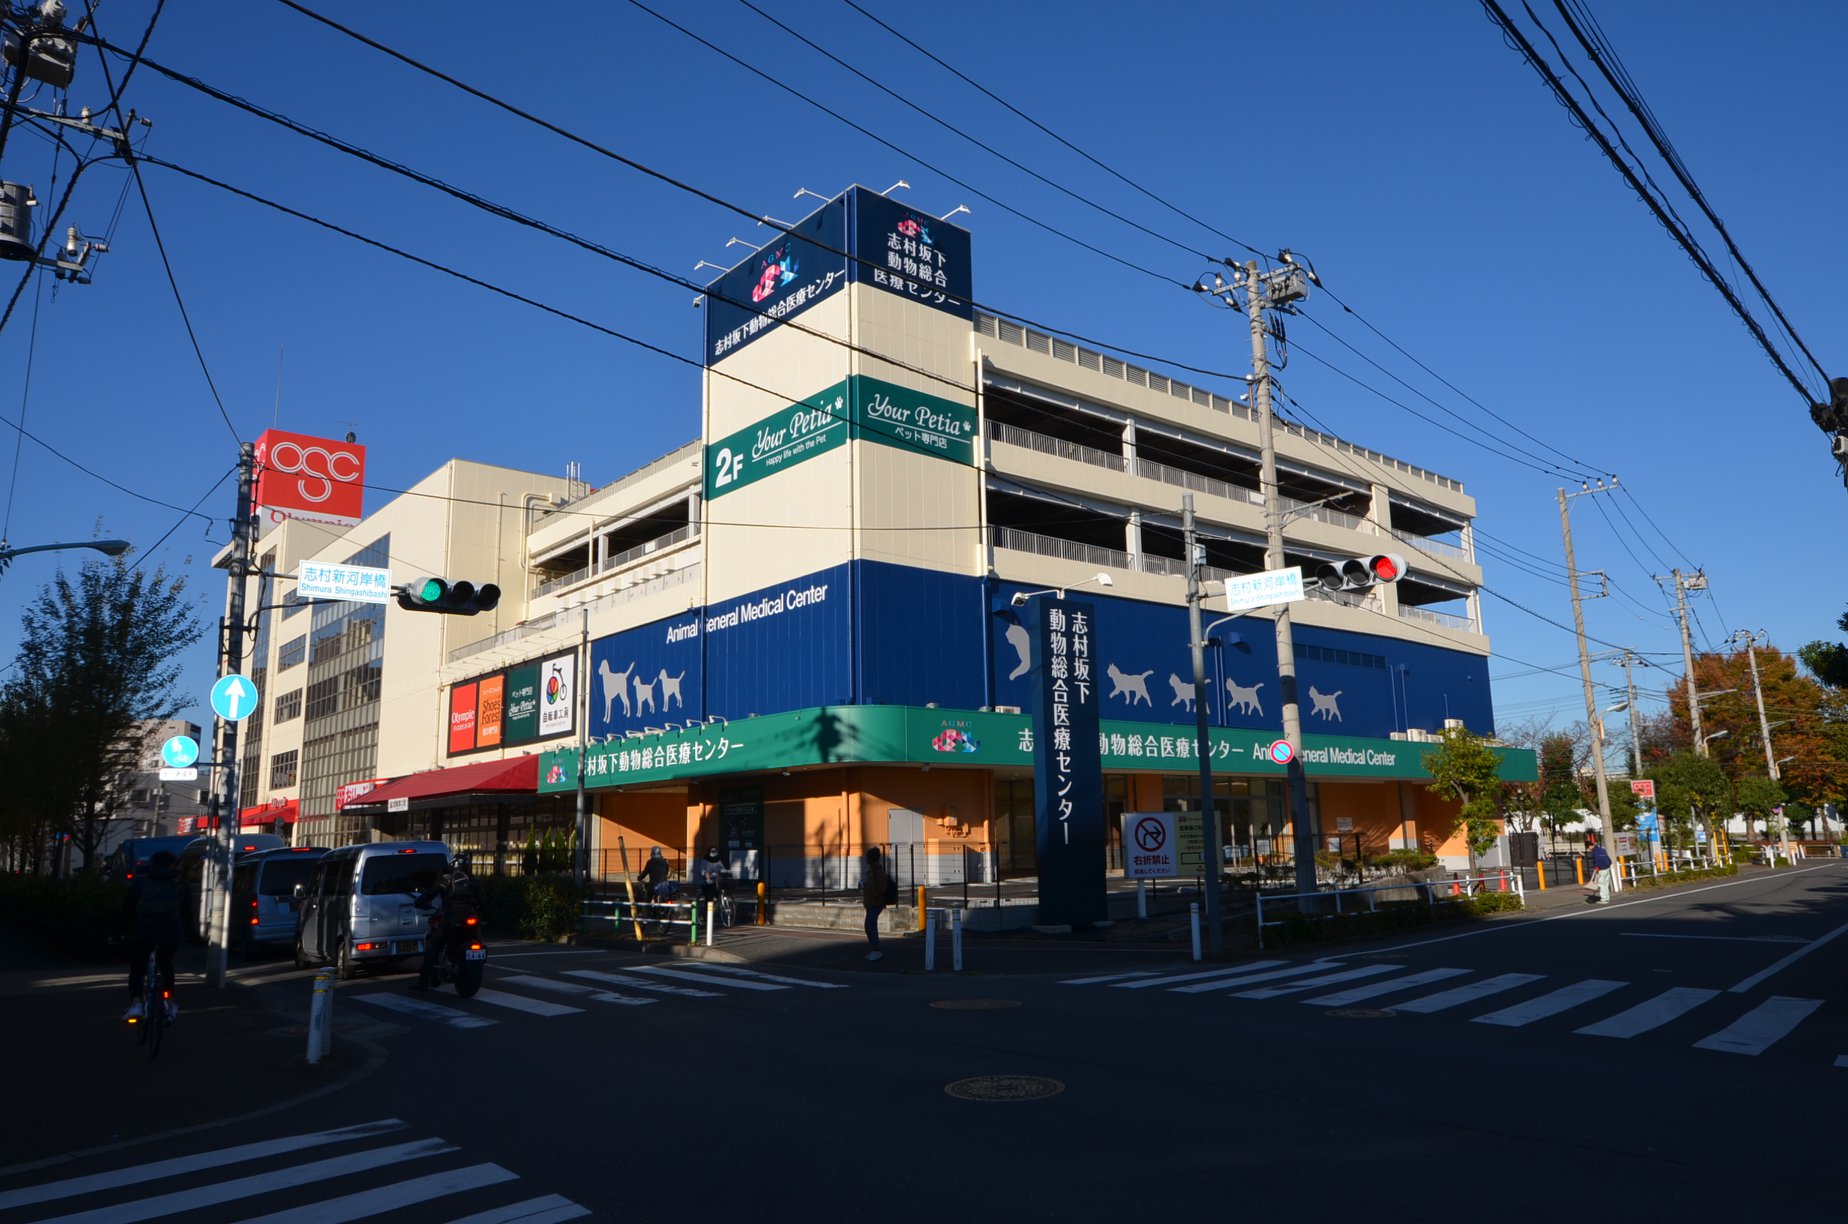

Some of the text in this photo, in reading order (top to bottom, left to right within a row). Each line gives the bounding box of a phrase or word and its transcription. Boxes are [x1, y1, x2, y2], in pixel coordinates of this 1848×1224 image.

[888, 233, 946, 267] 志村坂下
[874, 268, 961, 305] 医療センター
[888, 251, 947, 288] 動物総合
[752, 400, 832, 459] Your Petia
[867, 393, 961, 435] Your Petia
[766, 434, 827, 466] Happy life with the Pet
[895, 427, 948, 449] ペット専門店
[715, 448, 744, 488] 2F
[301, 583, 388, 599] Shimura Shingashibashi
[304, 567, 387, 589] 志村新河岸橋
[666, 619, 698, 644] Animal
[740, 593, 784, 623] Medical
[786, 584, 829, 610] Center
[1071, 611, 1091, 704] 志村坂下
[451, 709, 475, 723] Olympic
[483, 699, 501, 711] Shoes
[1049, 608, 1073, 845] 動物総合医療センター
[1253, 742, 1271, 760] Ani
[1330, 747, 1365, 765] Medical
[1367, 750, 1396, 766] Center
[1133, 855, 1170, 866] 右折禁止
